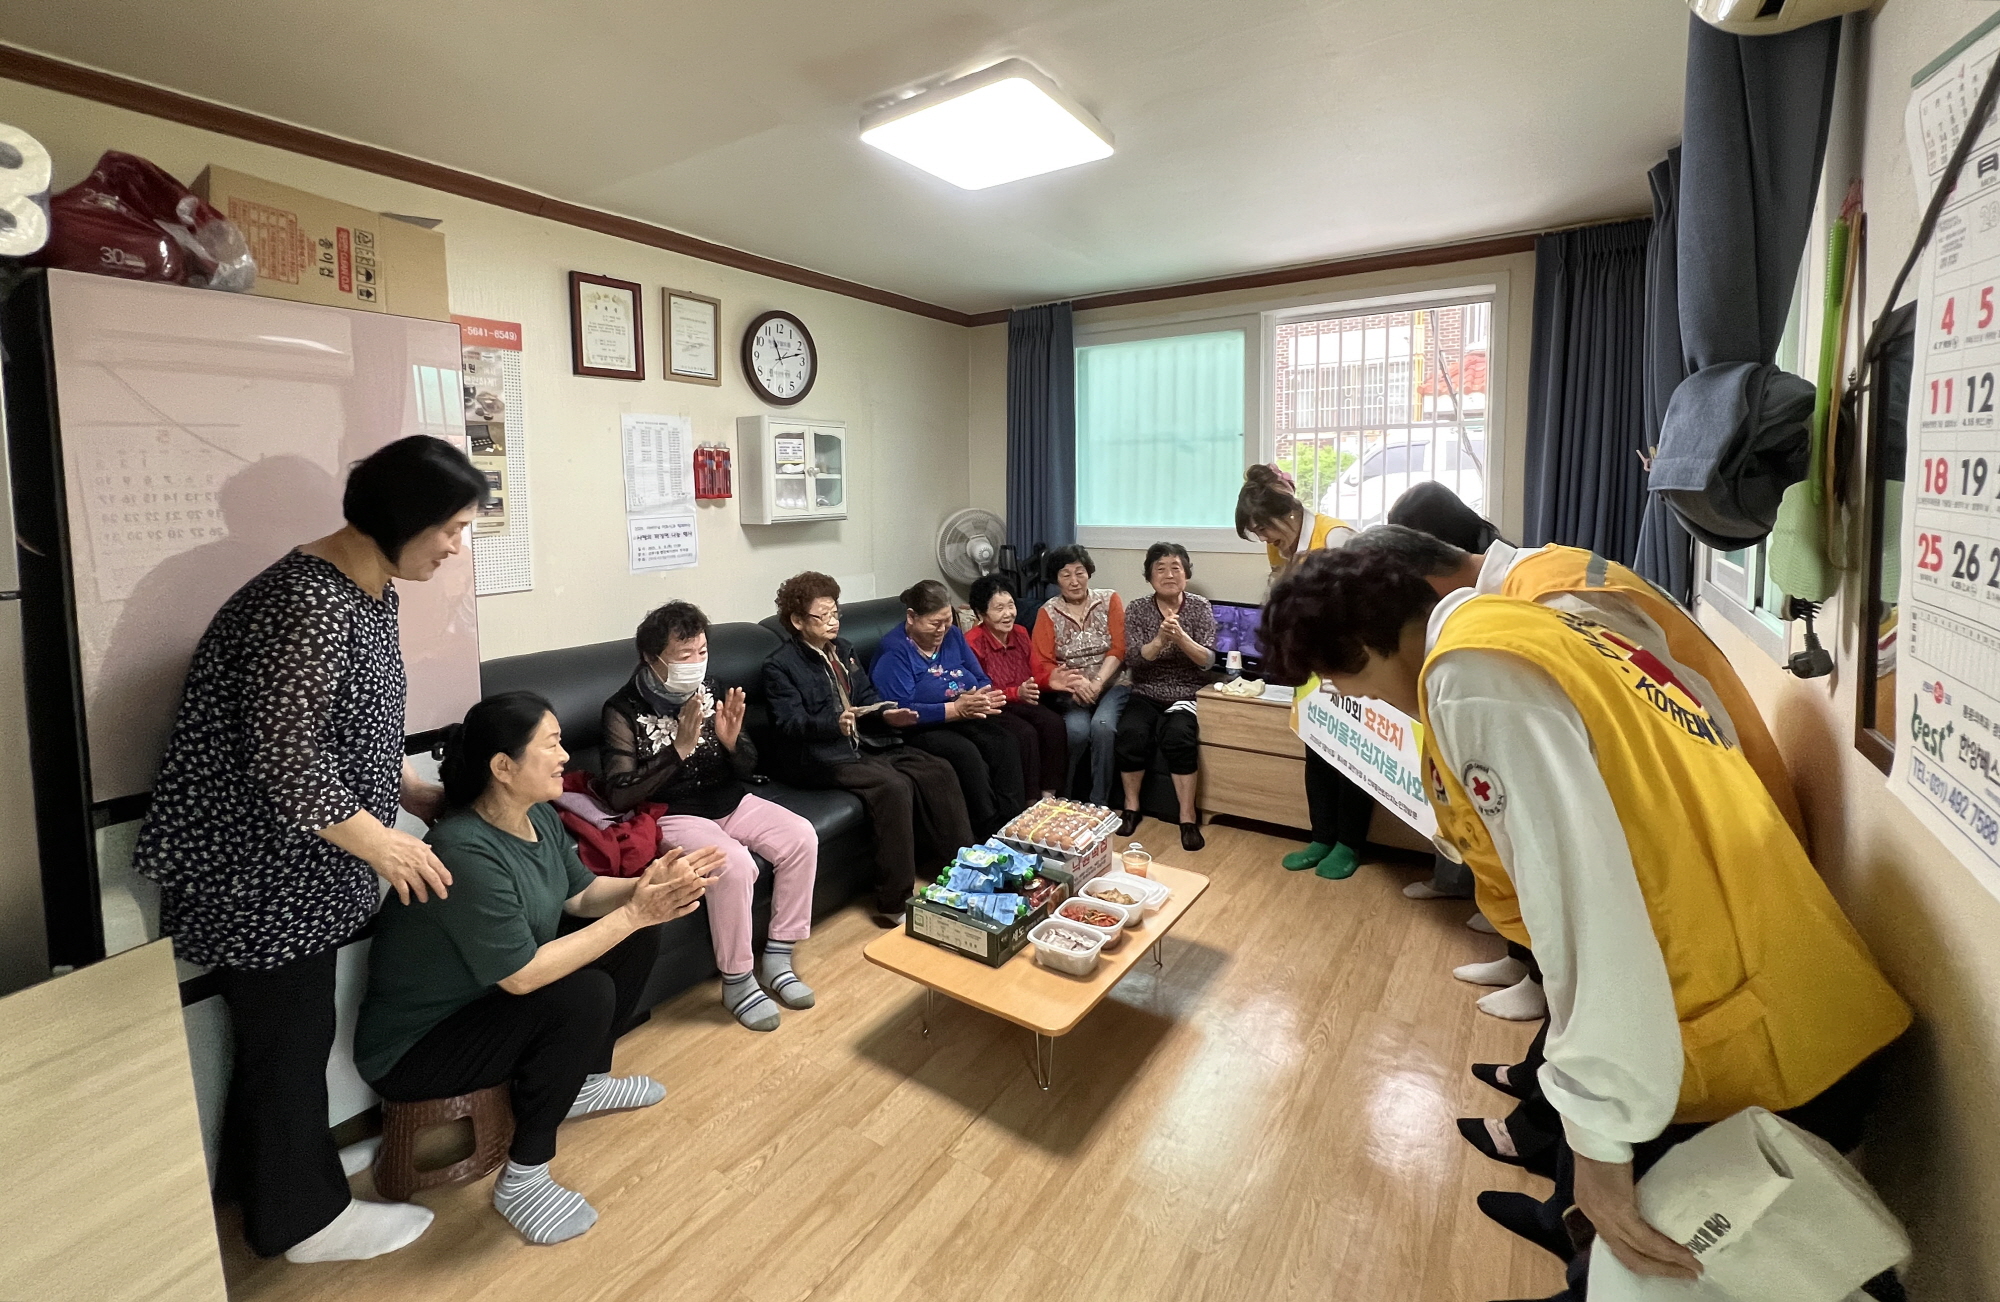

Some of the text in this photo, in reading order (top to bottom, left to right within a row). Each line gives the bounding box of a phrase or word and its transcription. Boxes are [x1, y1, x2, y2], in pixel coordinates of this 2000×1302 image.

[100, 246, 124, 265] 30
[318, 237, 334, 278] 종이컵
[1941, 286, 1994, 335] 4 5
[765, 326, 771, 336] 11
[776, 324, 784, 334] 12
[756, 336, 764, 347] 10
[797, 341, 802, 351] 2
[754, 351, 760, 360] 9
[799, 357, 805, 366] 3
[757, 366, 763, 376] 8
[796, 371, 802, 380] 4
[766, 379, 771, 388] 7
[778, 384, 784, 393] 6
[789, 381, 795, 391] 5
[1931, 372, 1994, 415] 11 12
[1924, 457, 1988, 496] 18 19
[1917, 532, 2000, 588] 25 26 2
[1330, 693, 1362, 723] 제10회
[1364, 706, 1404, 751] 효잔치
[1948, 787, 1970, 820] 492
[1970, 803, 1999, 845] 7588
